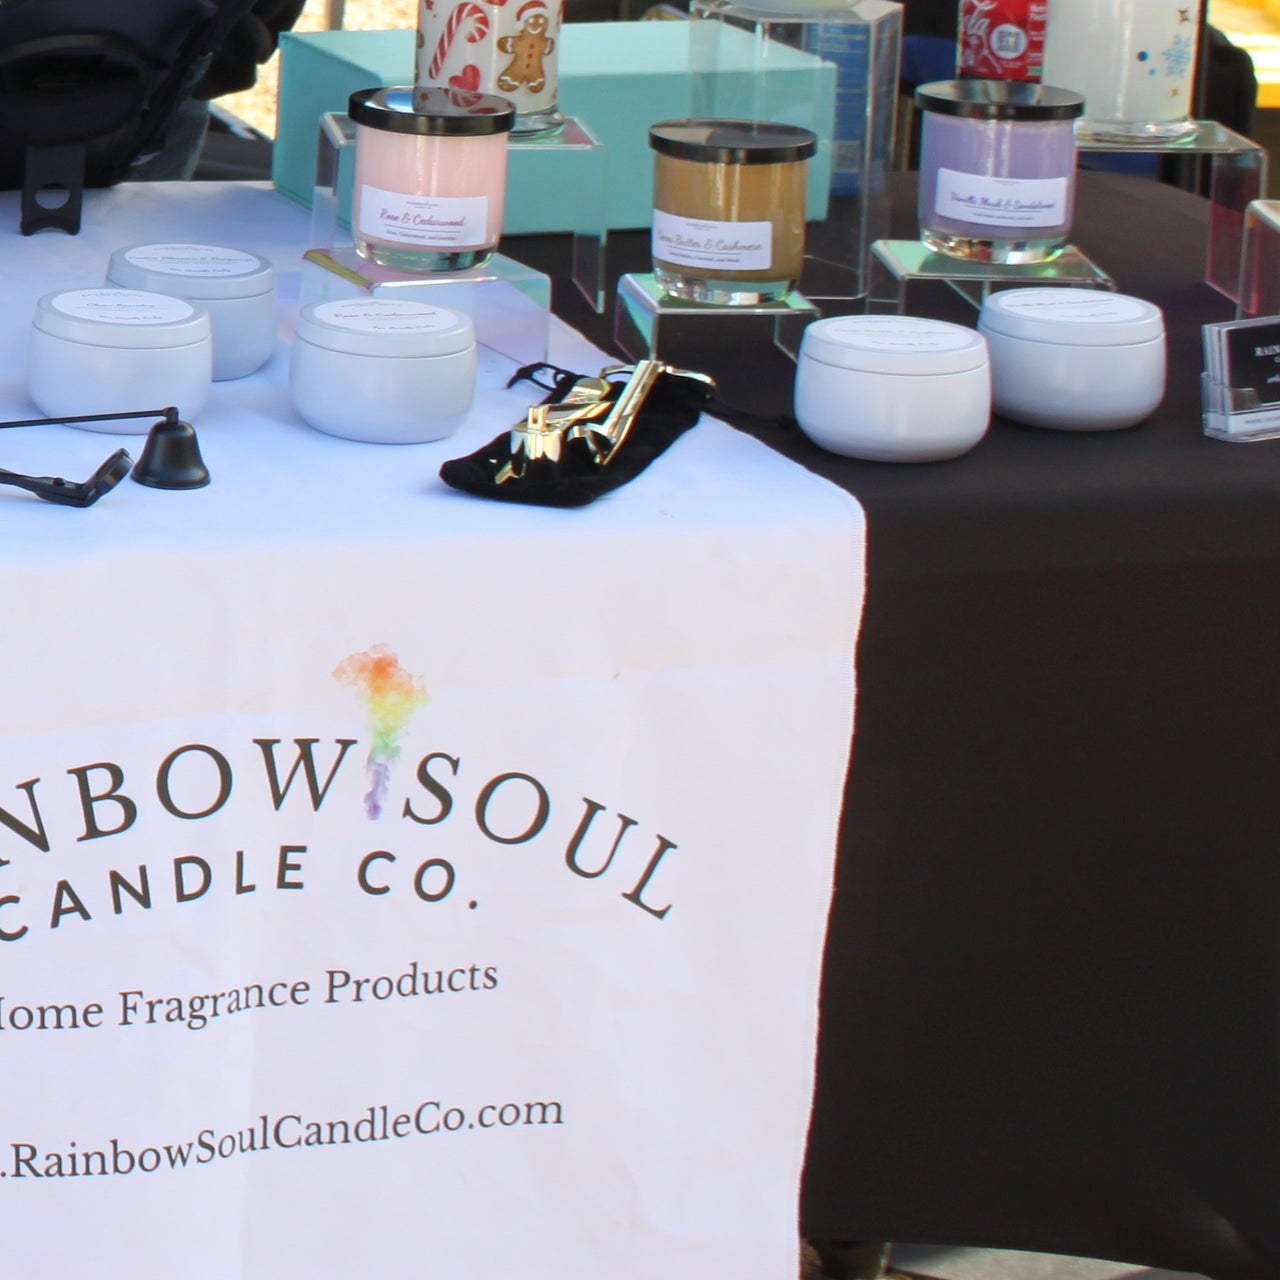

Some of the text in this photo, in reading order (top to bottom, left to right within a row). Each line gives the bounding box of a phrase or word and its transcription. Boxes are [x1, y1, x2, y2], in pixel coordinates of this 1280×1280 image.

[379, 207, 466, 227] Rose & Cedarwood
[675, 234, 702, 249] Butter
[703, 238, 713, 250] &
[715, 239, 763, 252] Cashmere
[402, 751, 681, 920] SOUL
[357, 850, 479, 910] CO.
[117, 973, 311, 1030] Fragrance
[323, 961, 499, 1006] Products
